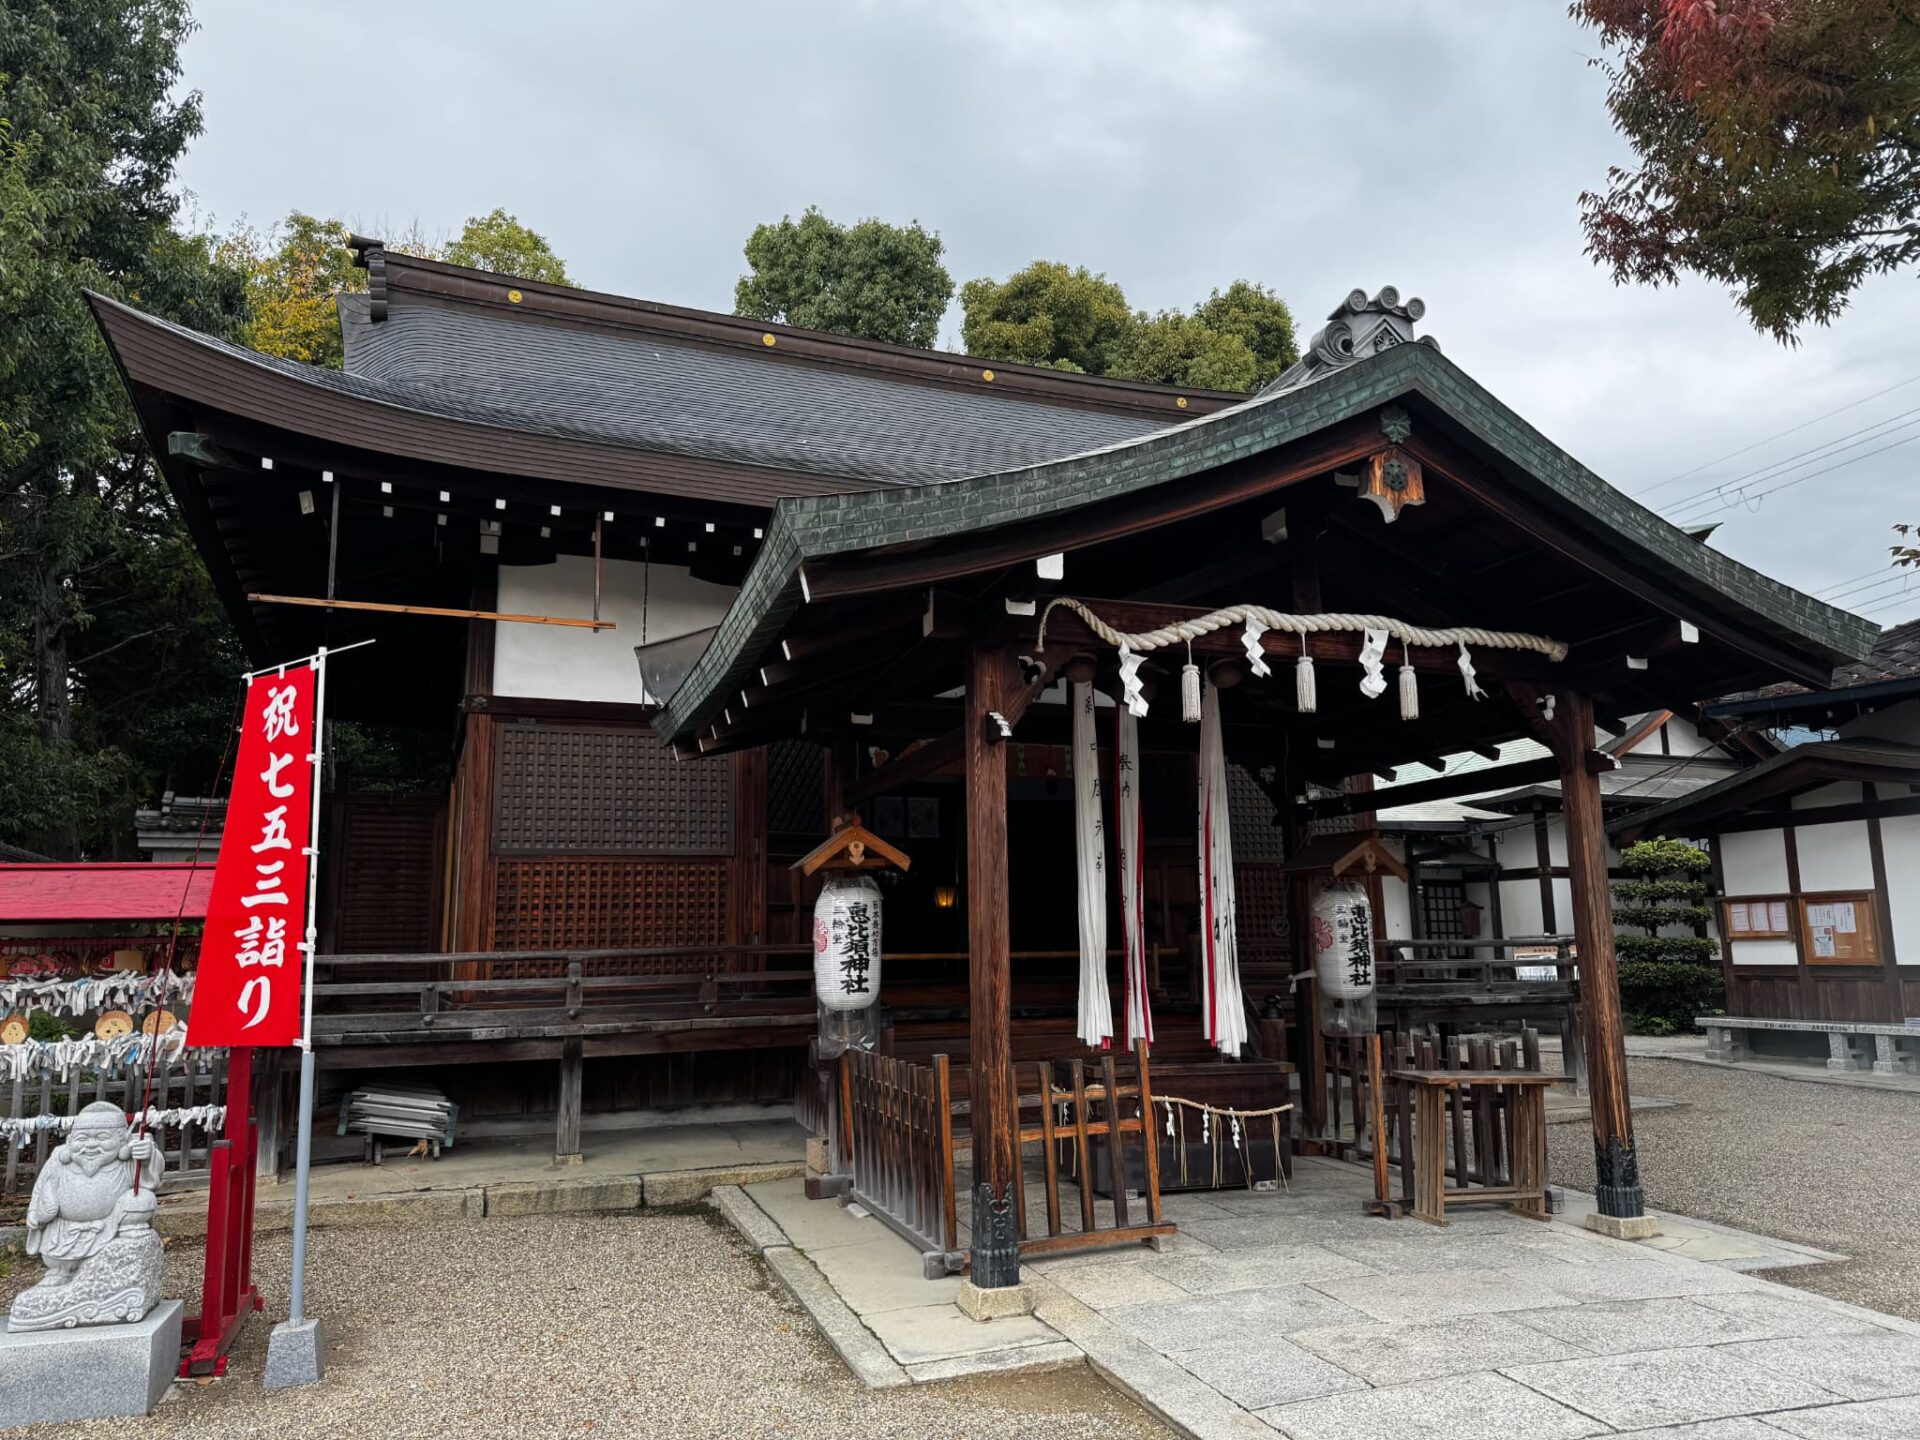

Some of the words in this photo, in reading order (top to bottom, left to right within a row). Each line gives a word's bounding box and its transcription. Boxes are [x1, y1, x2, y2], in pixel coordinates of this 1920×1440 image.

[235, 685, 299, 1030] 祝七五三詣り
[839, 902, 871, 995] 恵比須神社
[1347, 905, 1372, 986] 恵比須神社
